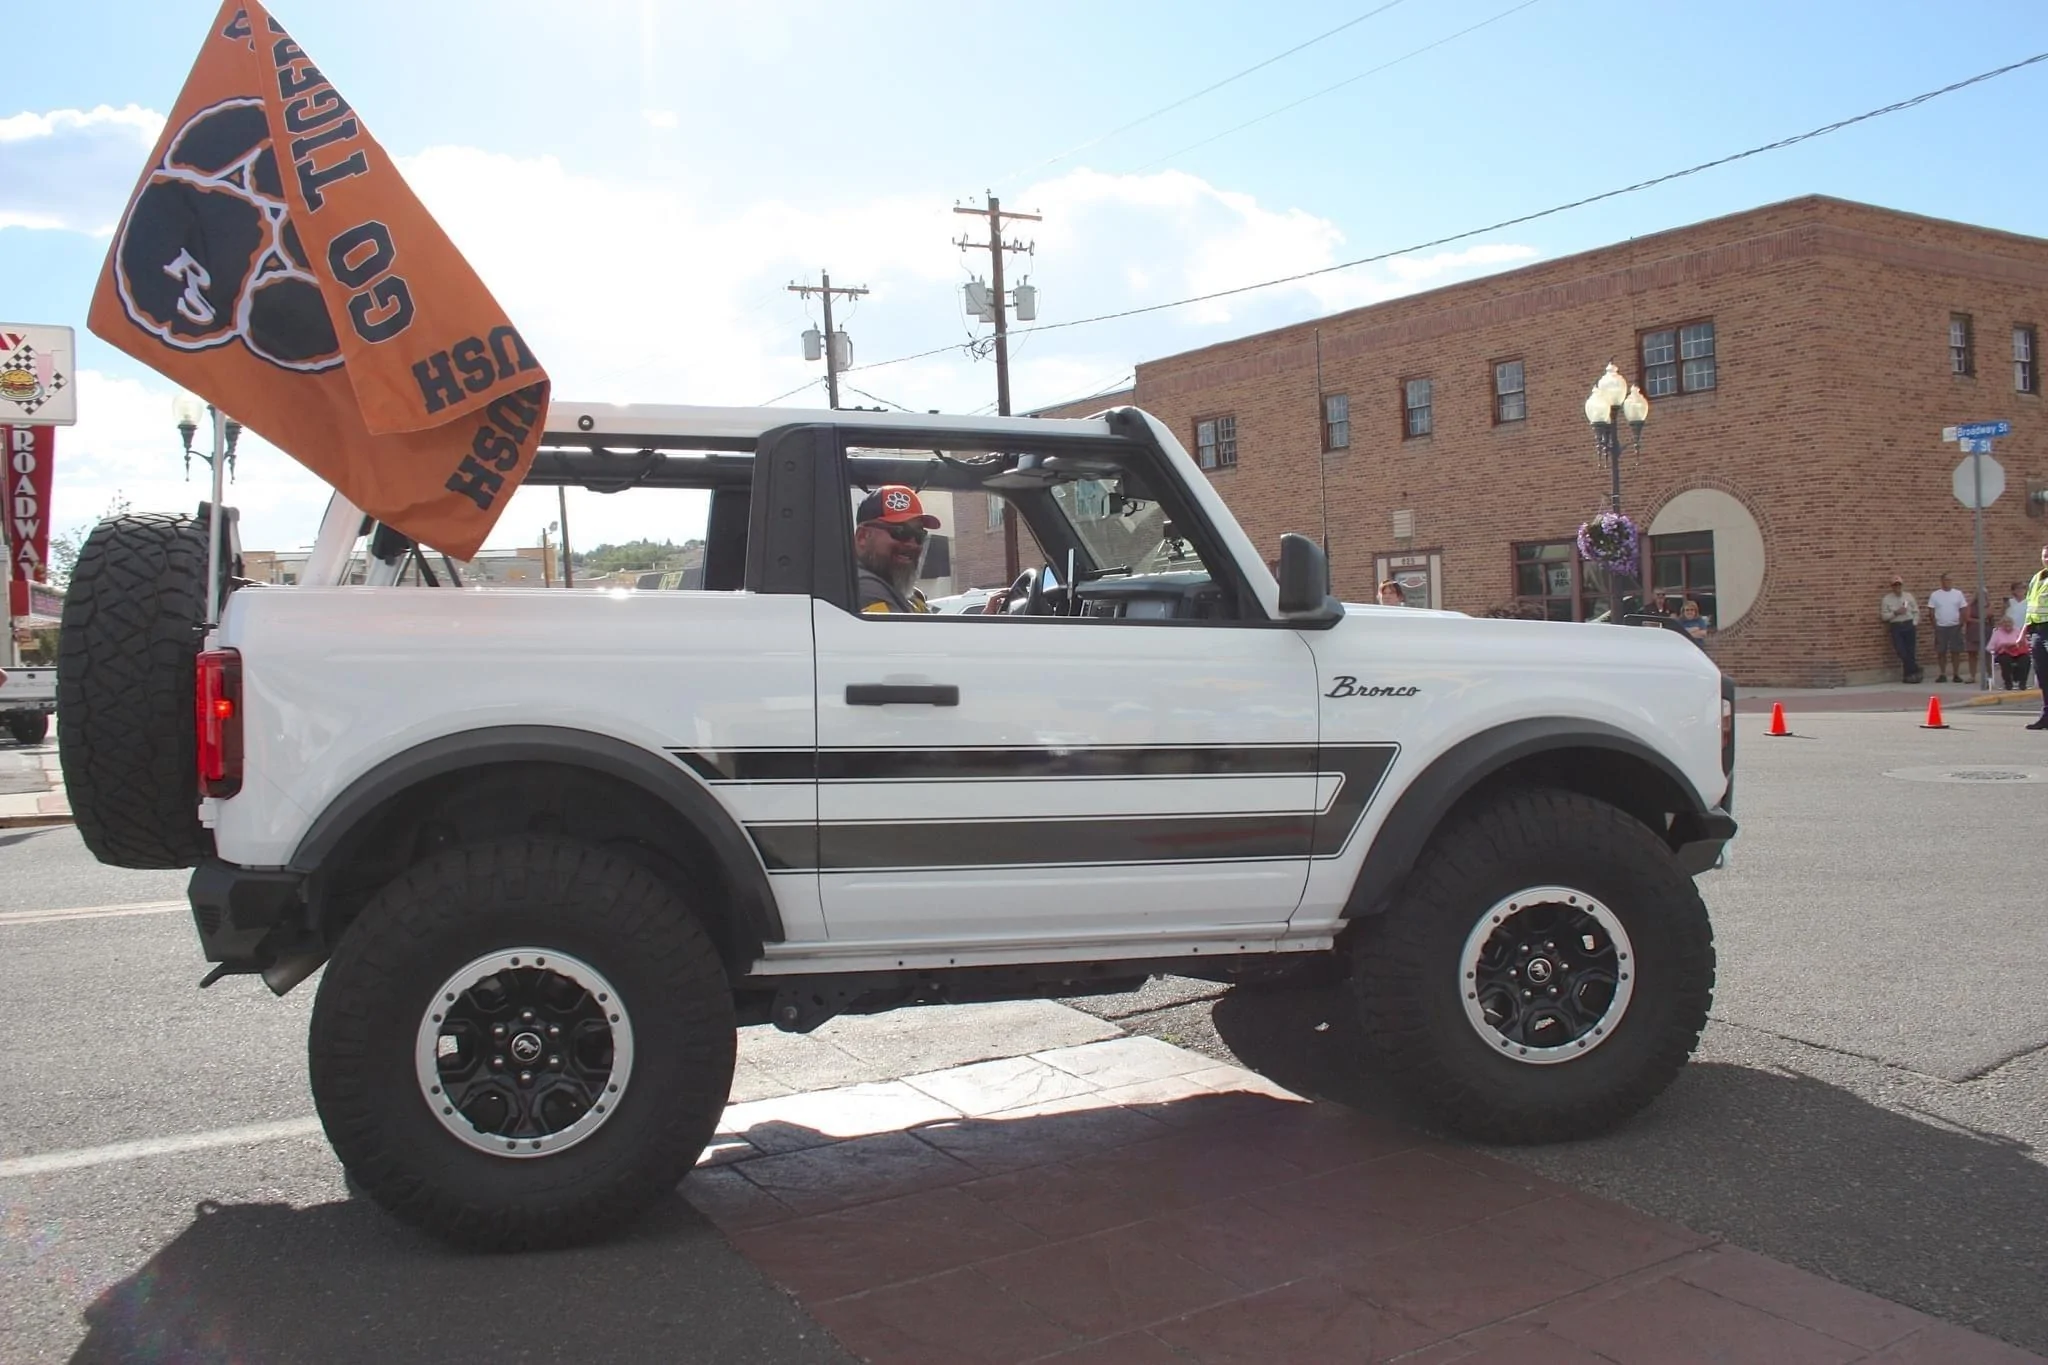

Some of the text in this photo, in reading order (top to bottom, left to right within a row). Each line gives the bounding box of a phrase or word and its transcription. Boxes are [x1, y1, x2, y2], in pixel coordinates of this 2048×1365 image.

[327, 220, 416, 344] GO
[1957, 423, 2008, 438] Broadway St
[1980, 440, 1991, 452] St
[12, 424, 41, 580] ROADWAY
[1324, 675, 1421, 698] Bronco
